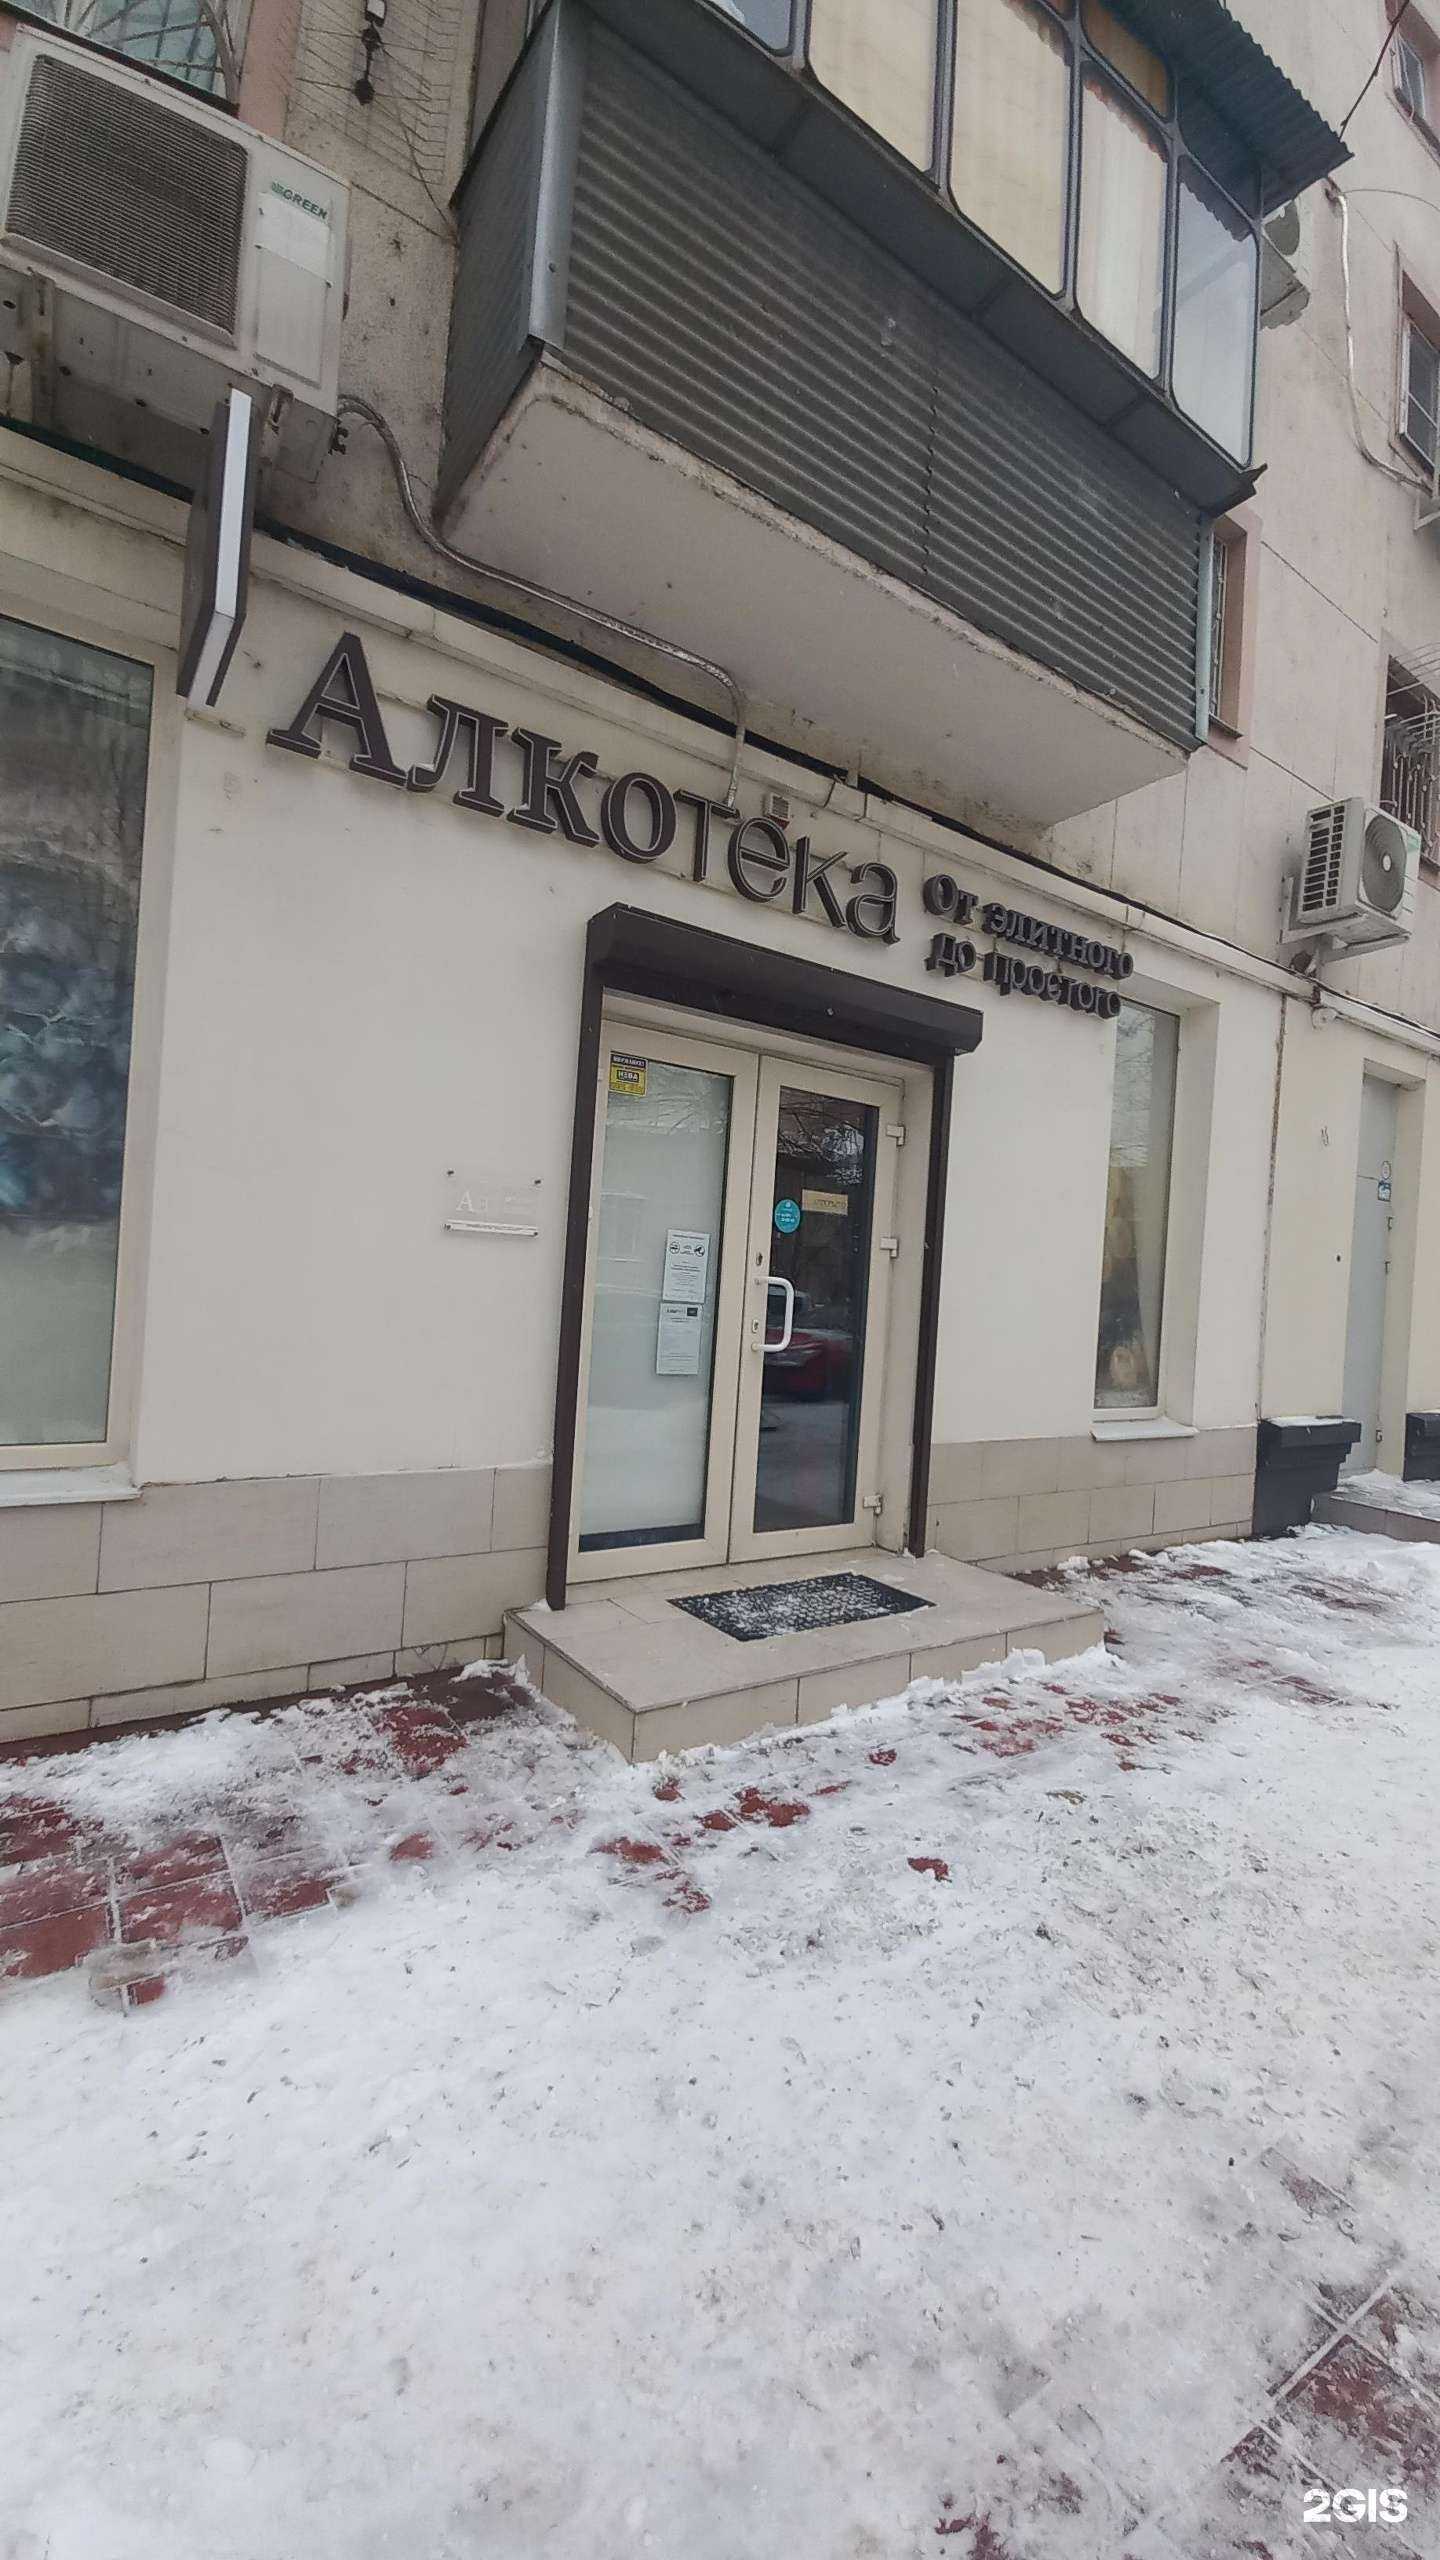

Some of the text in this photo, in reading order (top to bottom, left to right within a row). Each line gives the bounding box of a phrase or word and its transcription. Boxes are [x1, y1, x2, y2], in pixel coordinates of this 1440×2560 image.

[282, 188, 328, 219] GREEN
[267, 631, 902, 945] Алкотека
[923, 874, 1133, 980] От элитного
[924, 932, 1121, 1019] до простого
